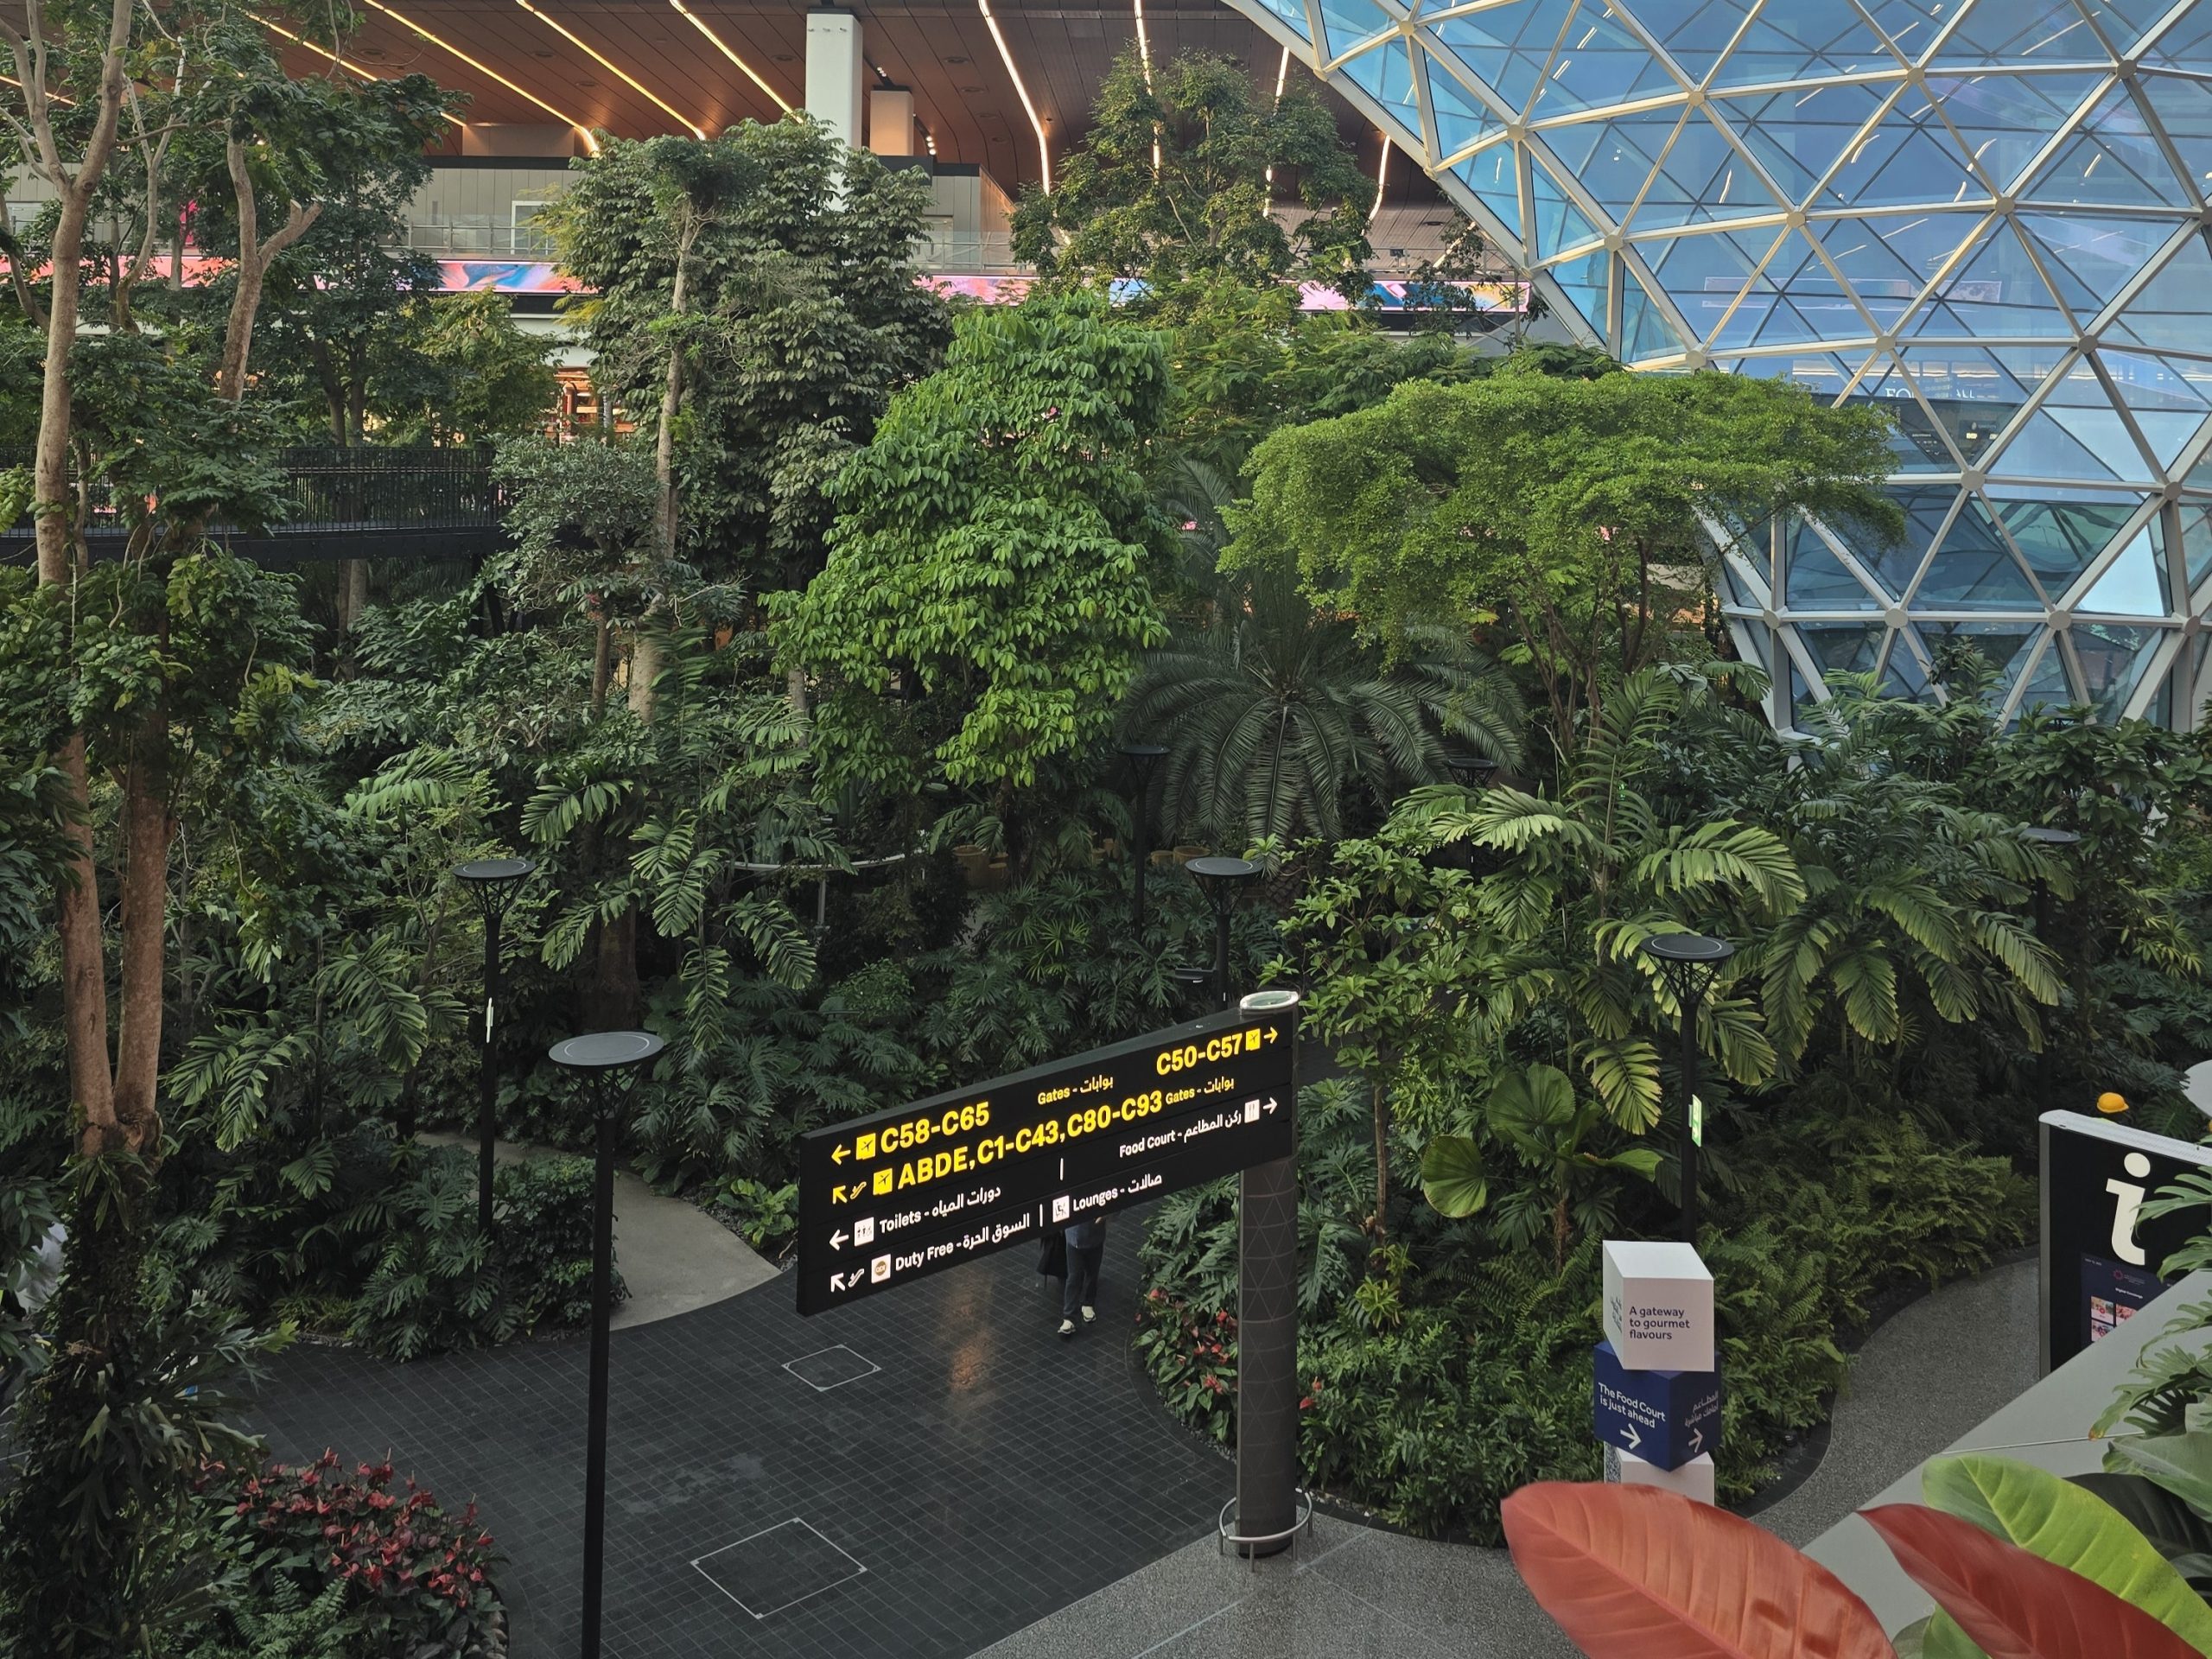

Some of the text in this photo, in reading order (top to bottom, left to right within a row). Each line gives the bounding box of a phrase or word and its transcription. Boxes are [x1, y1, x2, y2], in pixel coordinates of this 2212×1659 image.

[1156, 1033, 1243, 1076] C50-C57
[1038, 1086, 1071, 1105] Gates
[1079, 1075, 1113, 1094] بوابات
[1166, 1087, 1195, 1105] Gates
[1204, 1076, 1234, 1094] بوابات
[880, 1101, 989, 1154] C58-C65
[1184, 1114, 1224, 1143] المطاعم
[1224, 1109, 1242, 1128] ركن
[1119, 1137, 1145, 1158] Food
[1147, 1129, 1176, 1149] Court
[967, 1186, 1001, 1206] دورات
[1072, 1187, 1118, 1211] Lounges
[1128, 1173, 1162, 1193] صالات
[931, 1193, 964, 1217] المياه
[879, 1210, 922, 1233] Toilets
[991, 1212, 1030, 1243] السوق
[962, 1225, 989, 1249] الحرة
[895, 1251, 925, 1271] Duty
[927, 1242, 954, 1261] Free
[1629, 1306, 1685, 1319] A gateway
[1629, 1318, 1691, 1330] to gourmet
[1629, 1329, 1673, 1339] flavours
[1598, 1382, 1666, 1422] The Food Court
[1599, 1395, 1656, 1428] is just ahead
